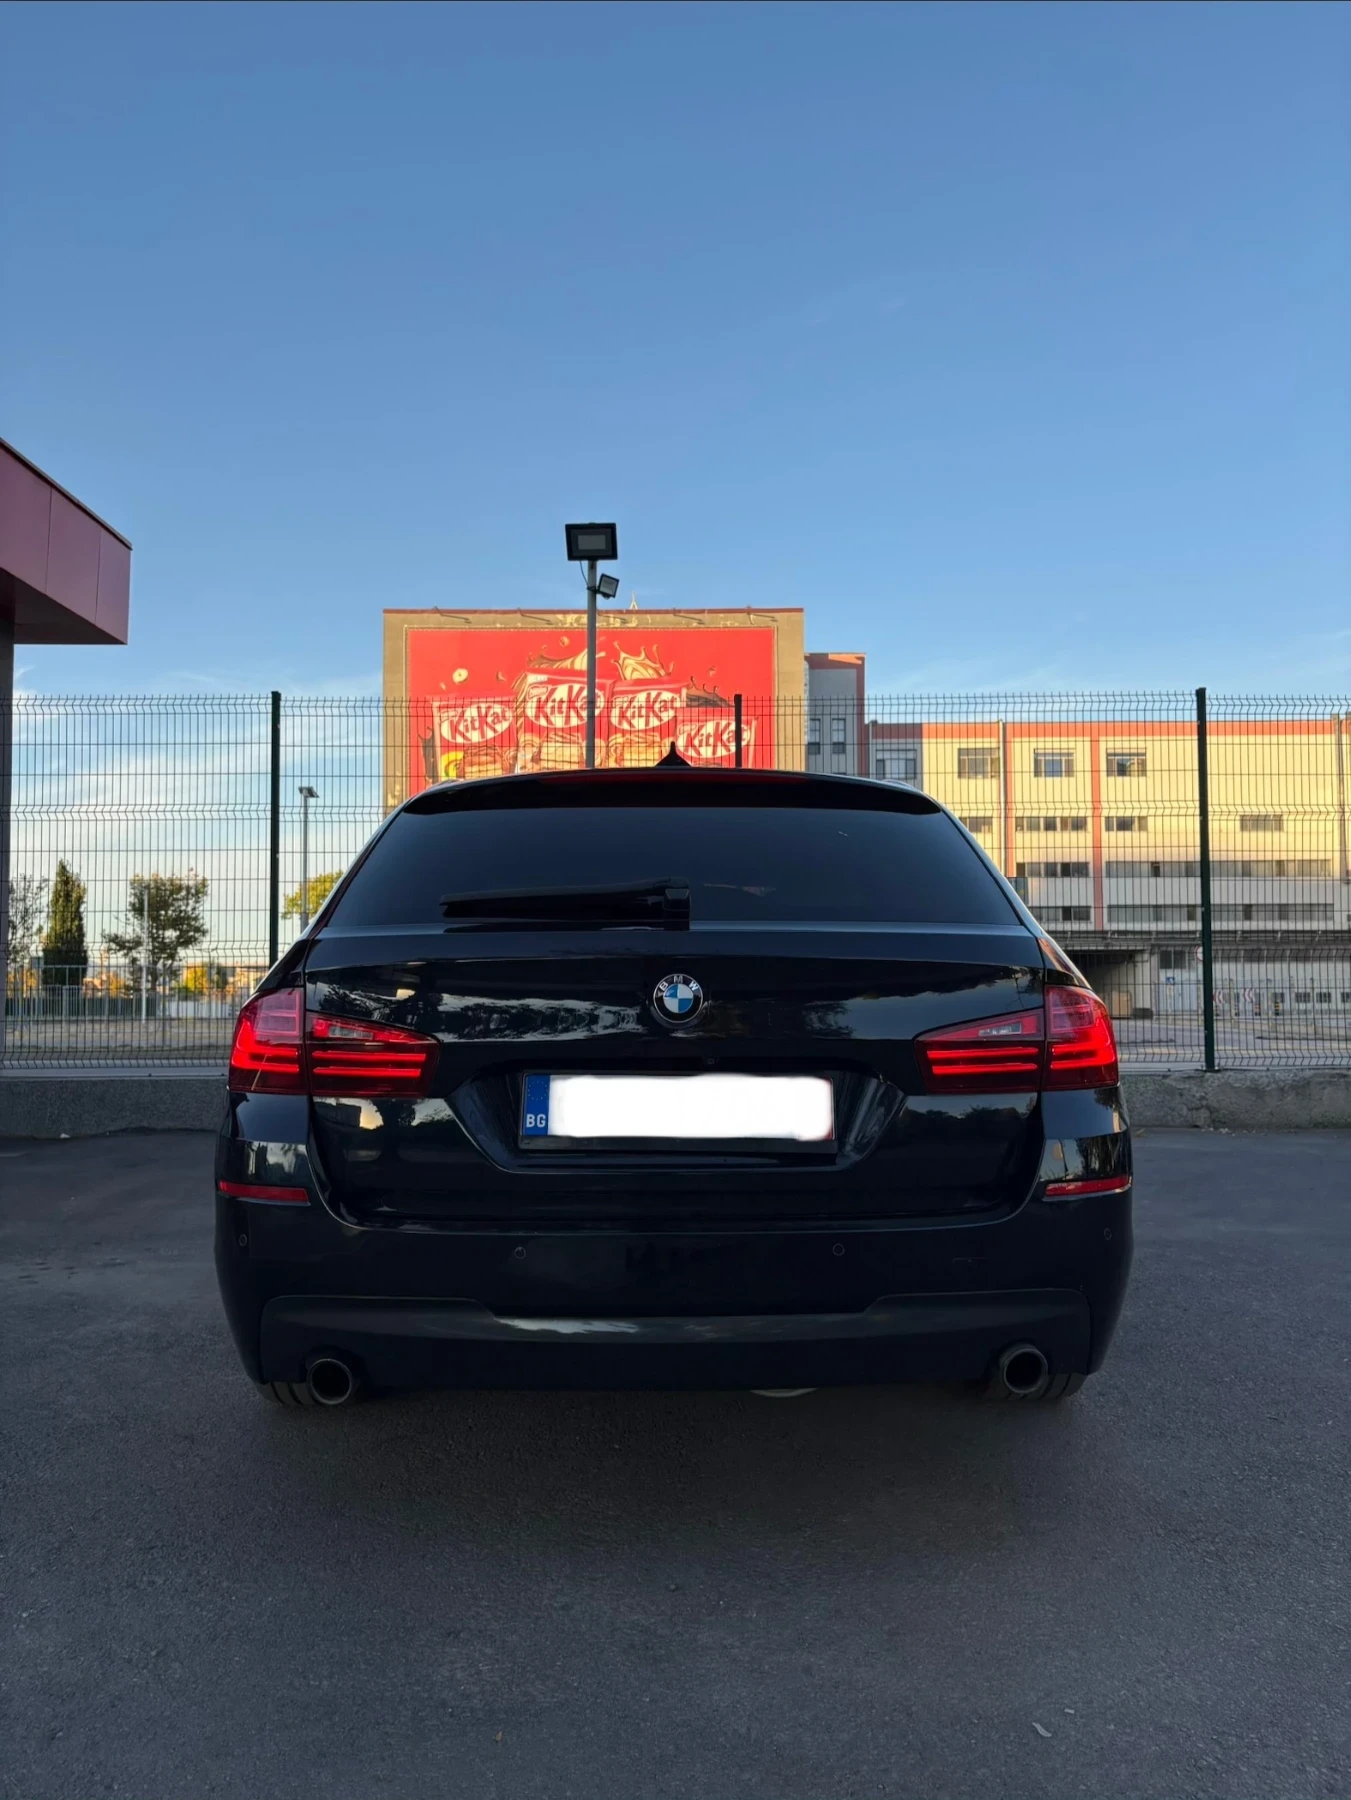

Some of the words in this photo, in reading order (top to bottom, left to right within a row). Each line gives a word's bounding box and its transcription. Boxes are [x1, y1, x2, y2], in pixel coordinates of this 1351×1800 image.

[449, 703, 510, 742] KitKat
[617, 691, 676, 729] KitKat
[658, 974, 699, 991] BMW
[526, 1113, 546, 1128] BG
